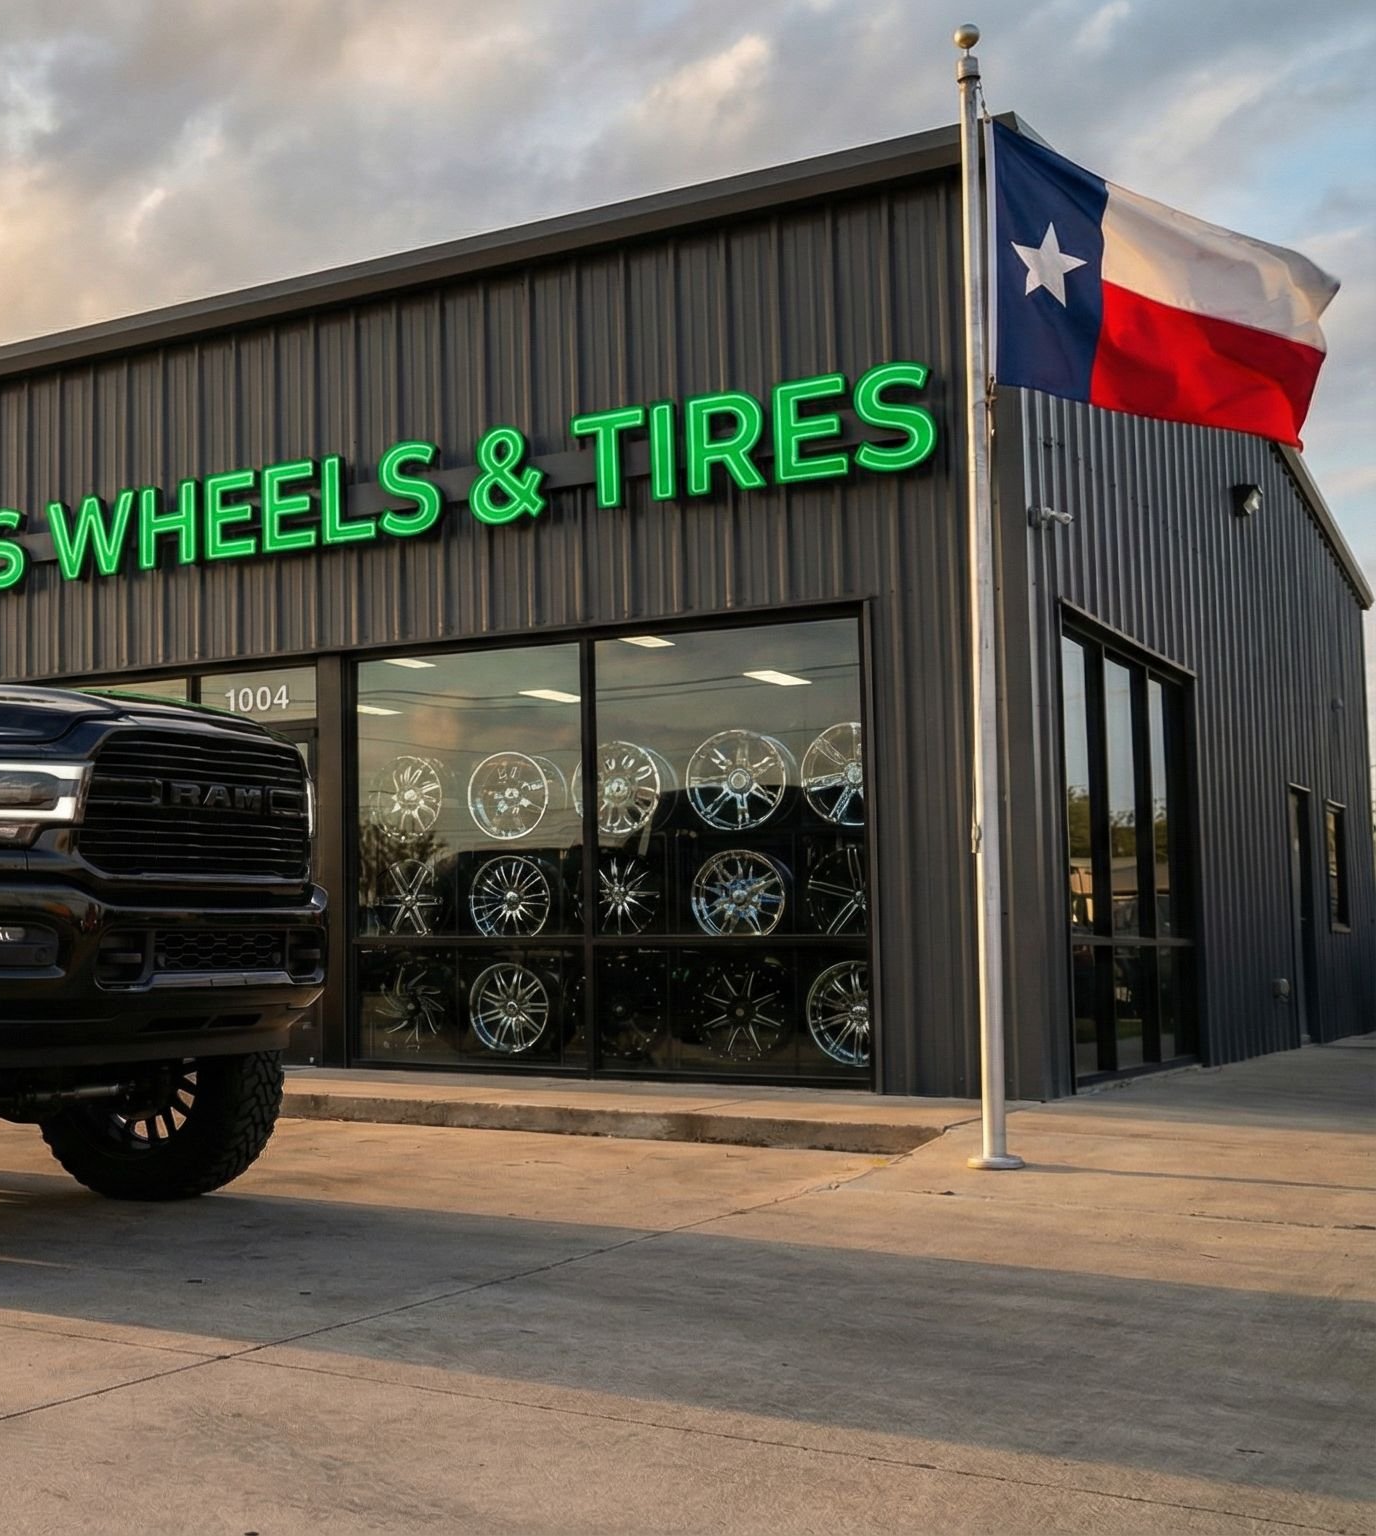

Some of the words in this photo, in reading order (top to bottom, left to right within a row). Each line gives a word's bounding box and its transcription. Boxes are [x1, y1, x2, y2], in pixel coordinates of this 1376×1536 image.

[44, 440, 442, 581] WHEELS
[467, 425, 546, 525] &
[569, 361, 937, 509] TIRES
[224, 684, 290, 712] 1004
[170, 783, 261, 811] RAM
